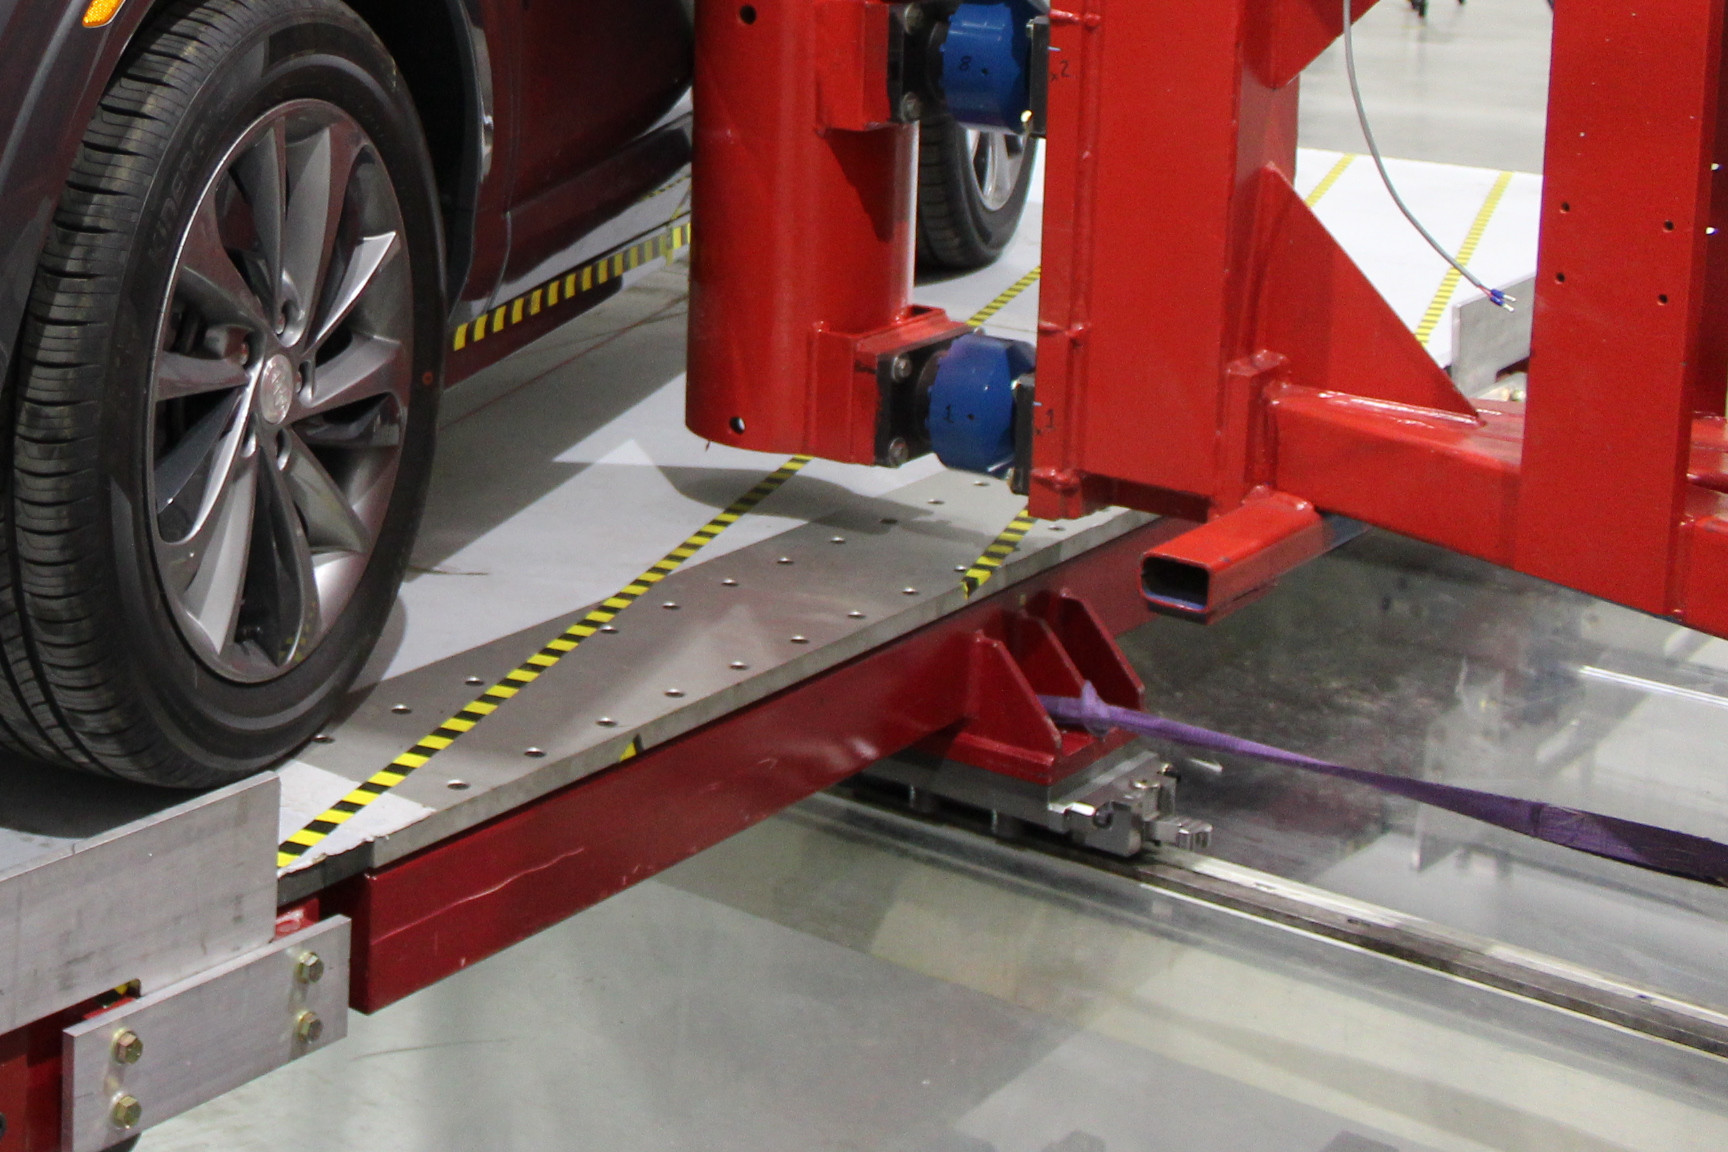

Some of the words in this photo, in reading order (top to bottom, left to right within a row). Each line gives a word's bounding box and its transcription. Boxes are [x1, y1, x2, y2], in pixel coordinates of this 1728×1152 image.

[959, 55, 973, 72] 8
[1059, 59, 1071, 78] 2
[944, 405, 954, 424] 1
[1046, 409, 1055, 429] 1
